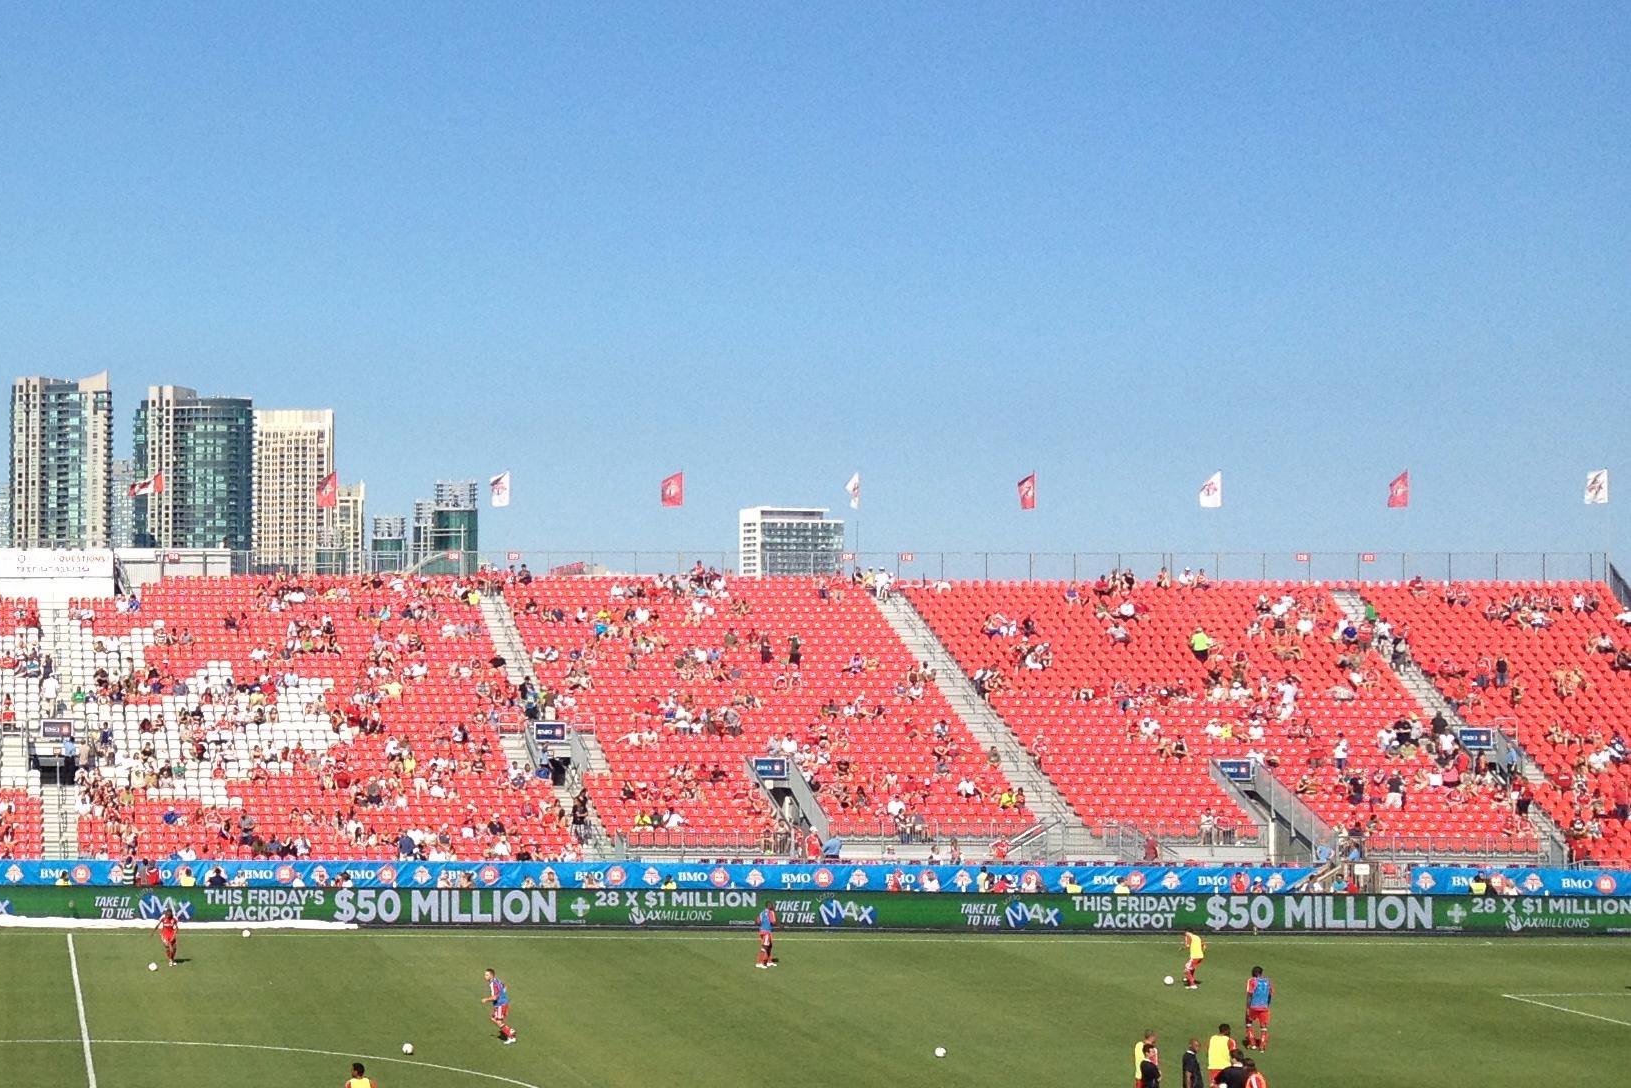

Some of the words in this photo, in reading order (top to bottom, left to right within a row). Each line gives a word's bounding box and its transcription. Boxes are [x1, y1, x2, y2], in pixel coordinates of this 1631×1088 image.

[245, 869, 273, 878] BMO
[678, 872, 707, 882] BMO
[781, 874, 811, 882] BMO
[1198, 876, 1227, 886] BMO
[1452, 876, 1474, 886] BM
[1561, 878, 1592, 888] BMO
[95, 896, 118, 908] TAKE
[120, 896, 131, 908] IT
[205, 890, 245, 905] THIS
[248, 890, 324, 905] FRIDAY'S
[595, 892, 618, 906] 28
[625, 892, 640, 906] X
[645, 892, 664, 907] $1
[671, 892, 756, 907] MILLION
[335, 888, 401, 922] $50
[411, 890, 557, 922] MILLION
[775, 900, 799, 912] TAKE
[800, 900, 812, 912] IT
[961, 903, 985, 915] TAKE
[986, 903, 998, 915] IT
[1072, 896, 1113, 912] THIS
[1117, 896, 1195, 912] FRIDAY'S
[1473, 898, 1496, 914] 28
[1503, 898, 1517, 914] X
[1523, 898, 1542, 915] $1
[1549, 898, 1631, 915] MILLION
[102, 908, 115, 919] TO
[117, 908, 134, 919] THE
[226, 907, 303, 921] JACKPOT
[1206, 895, 1273, 929] $50
[1285, 896, 1433, 929] MILLION
[782, 913, 795, 924] TO
[797, 913, 815, 924] THE
[968, 915, 980, 926] TO
[983, 915, 1001, 926] THE
[1094, 913, 1175, 929] JACKPOT
